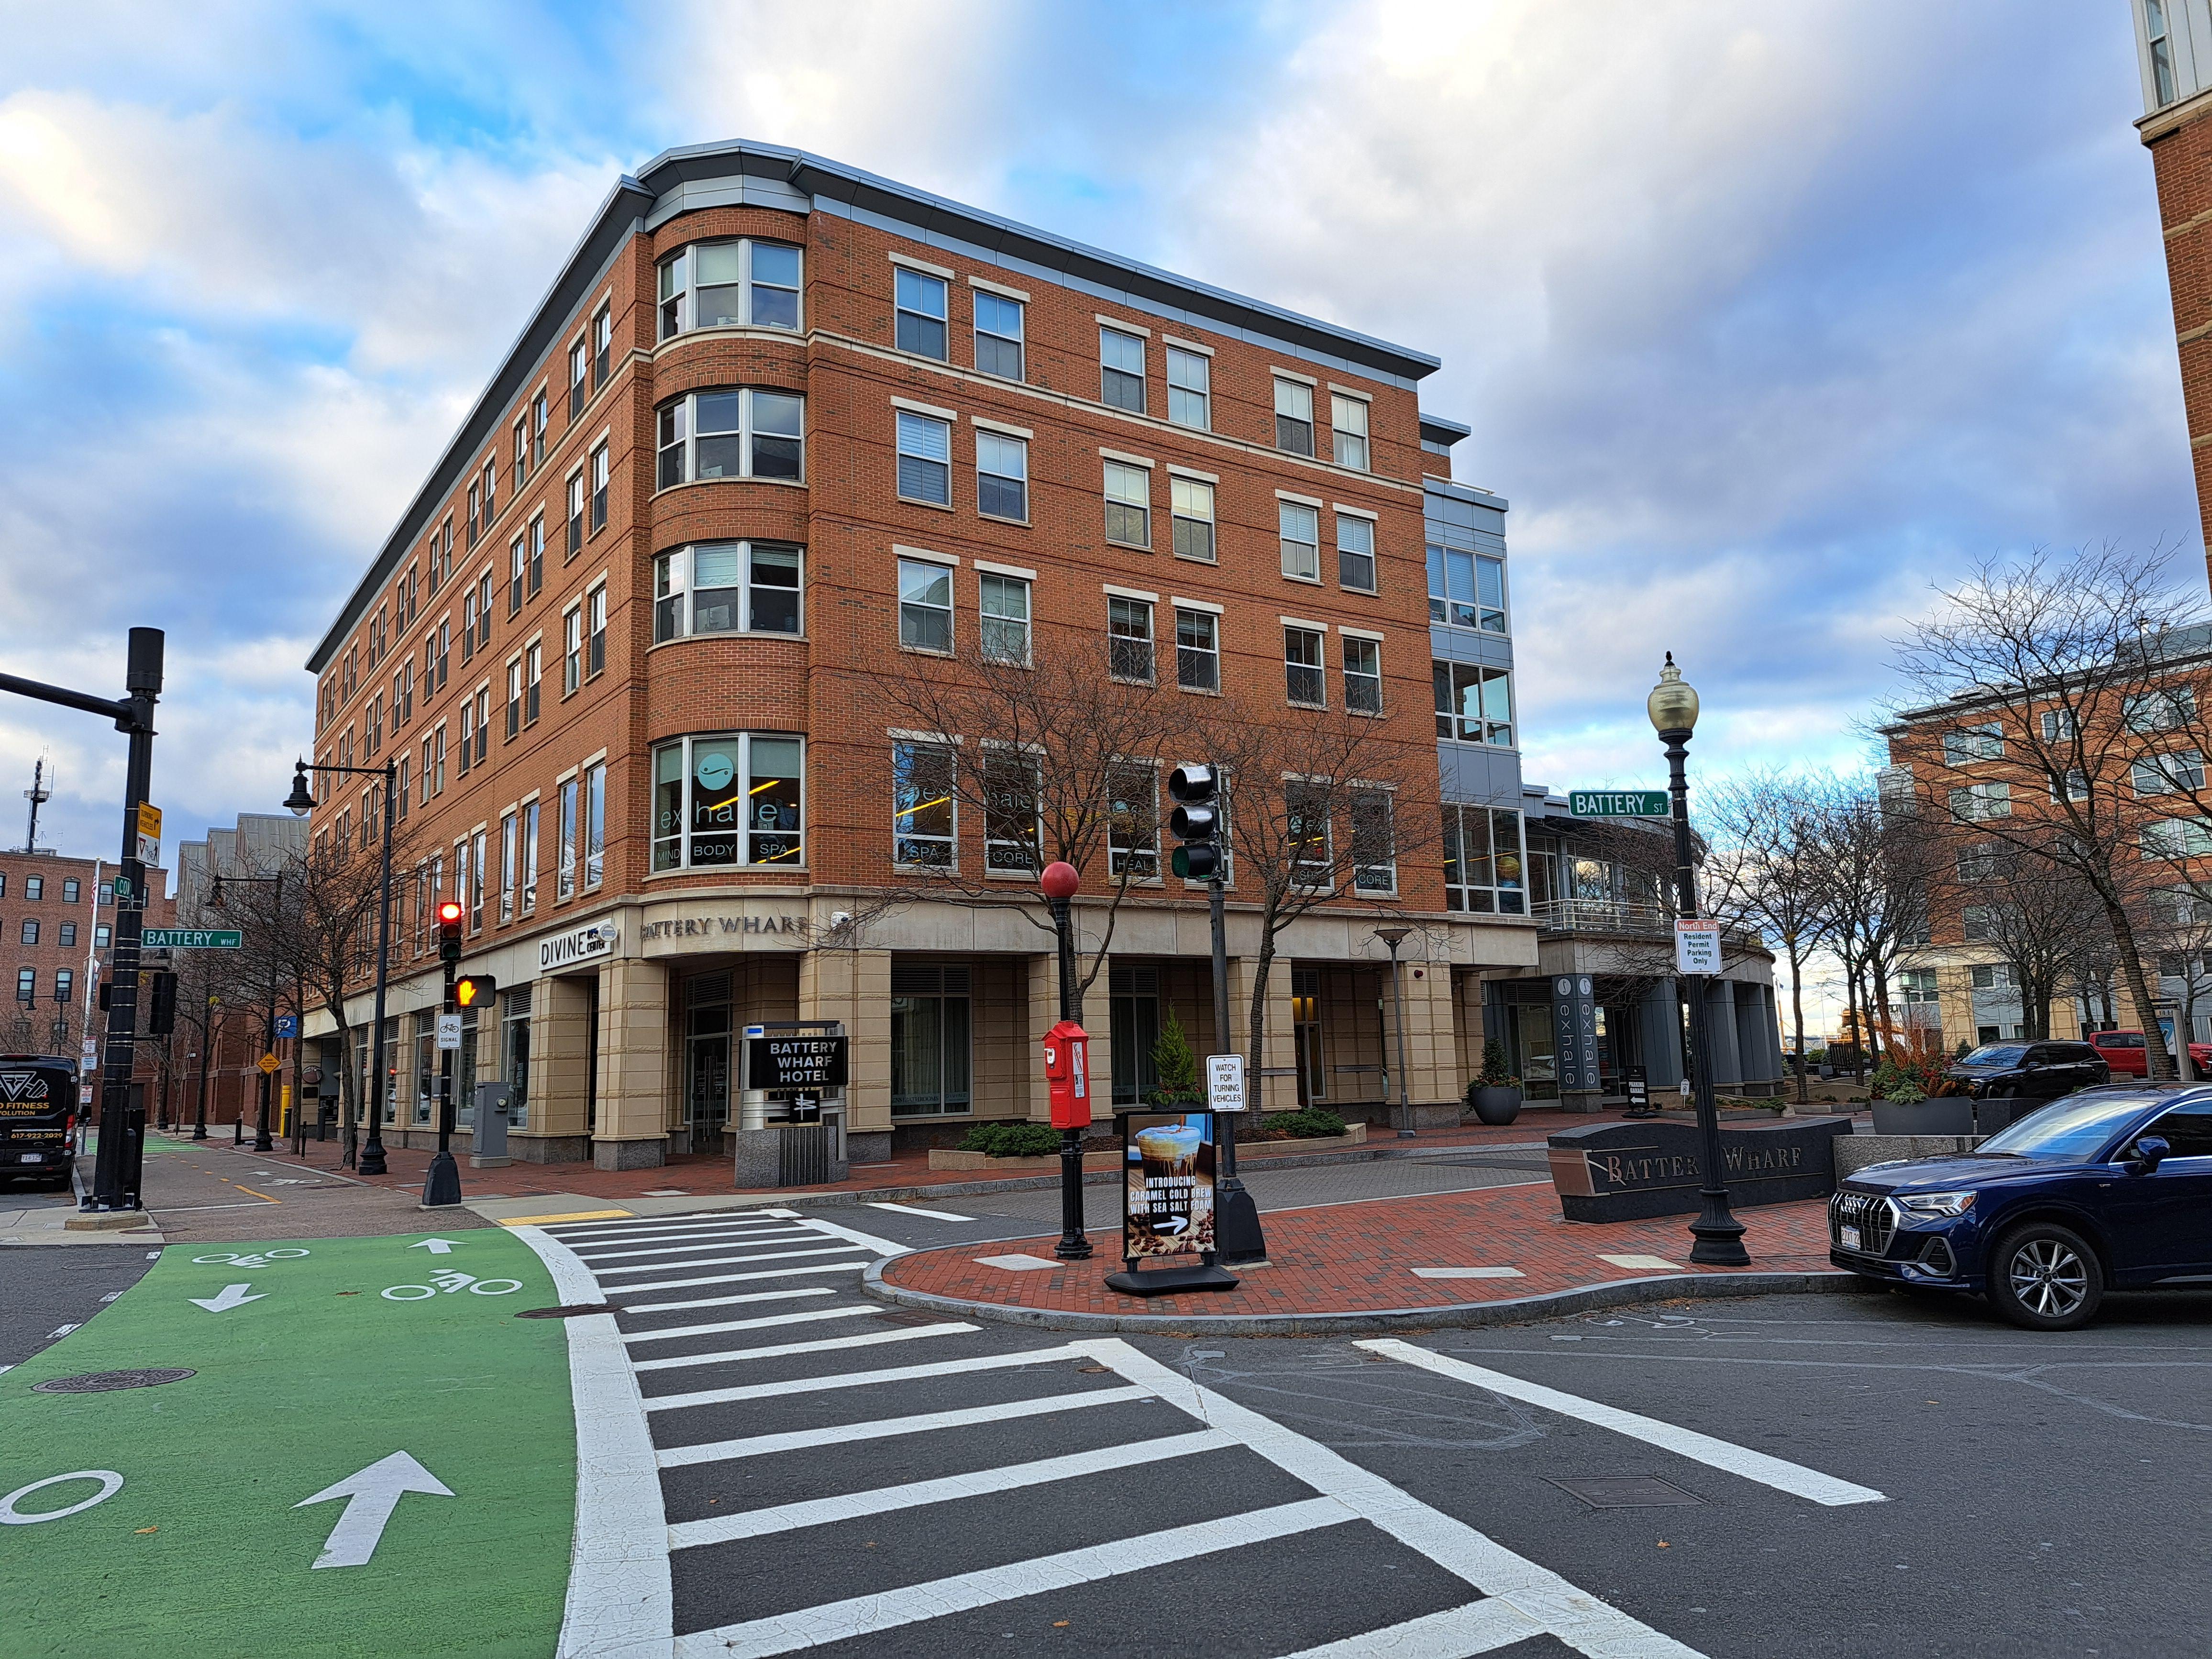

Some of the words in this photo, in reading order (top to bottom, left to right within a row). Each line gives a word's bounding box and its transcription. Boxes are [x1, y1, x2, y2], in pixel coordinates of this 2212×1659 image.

[1576, 795, 1646, 813] BATTERY
[1654, 803, 1663, 813] ST
[658, 849, 680, 862] MIND
[694, 844, 735, 856] BODY
[760, 844, 788, 854] SPA
[909, 847, 939, 859] SPA
[1117, 859, 1150, 871] HEAL
[1359, 874, 1389, 885] CORE
[640, 918, 712, 940] BATTERY
[718, 916, 807, 932] WHARF
[1679, 921, 1700, 930] North
[1703, 921, 1717, 929] End
[147, 931, 213, 945] BATTERY
[542, 931, 586, 965] DIVINE
[1693, 957, 1708, 965] Only
[277, 1019, 291, 1034] P
[770, 1042, 837, 1054] BATTERY
[1560, 1004, 1577, 1085] exhale
[1582, 1003, 1597, 1085] exhale
[777, 1056, 832, 1068] WHARF
[1216, 1063, 1236, 1072] WATCH
[780, 1070, 830, 1083] HOTEL
[1214, 1084, 1239, 1092] TURNING
[1213, 1094, 1241, 1103] VEHICLES
[1606, 1155, 1701, 1183] BATTER
[1722, 1146, 1802, 1172] WHARF
[1146, 1175, 1196, 1188] INTRODUCING
[1130, 1190, 1167, 1202] CARAMEL
[1169, 1188, 1189, 1200] COLD
[1191, 1186, 1212, 1199] BREW
[1130, 1203, 1150, 1214] WITH
[1153, 1202, 1167, 1213] SEA
[1170, 1201, 1188, 1212] SALT
[1191, 1199, 1212, 1211] FOAM
